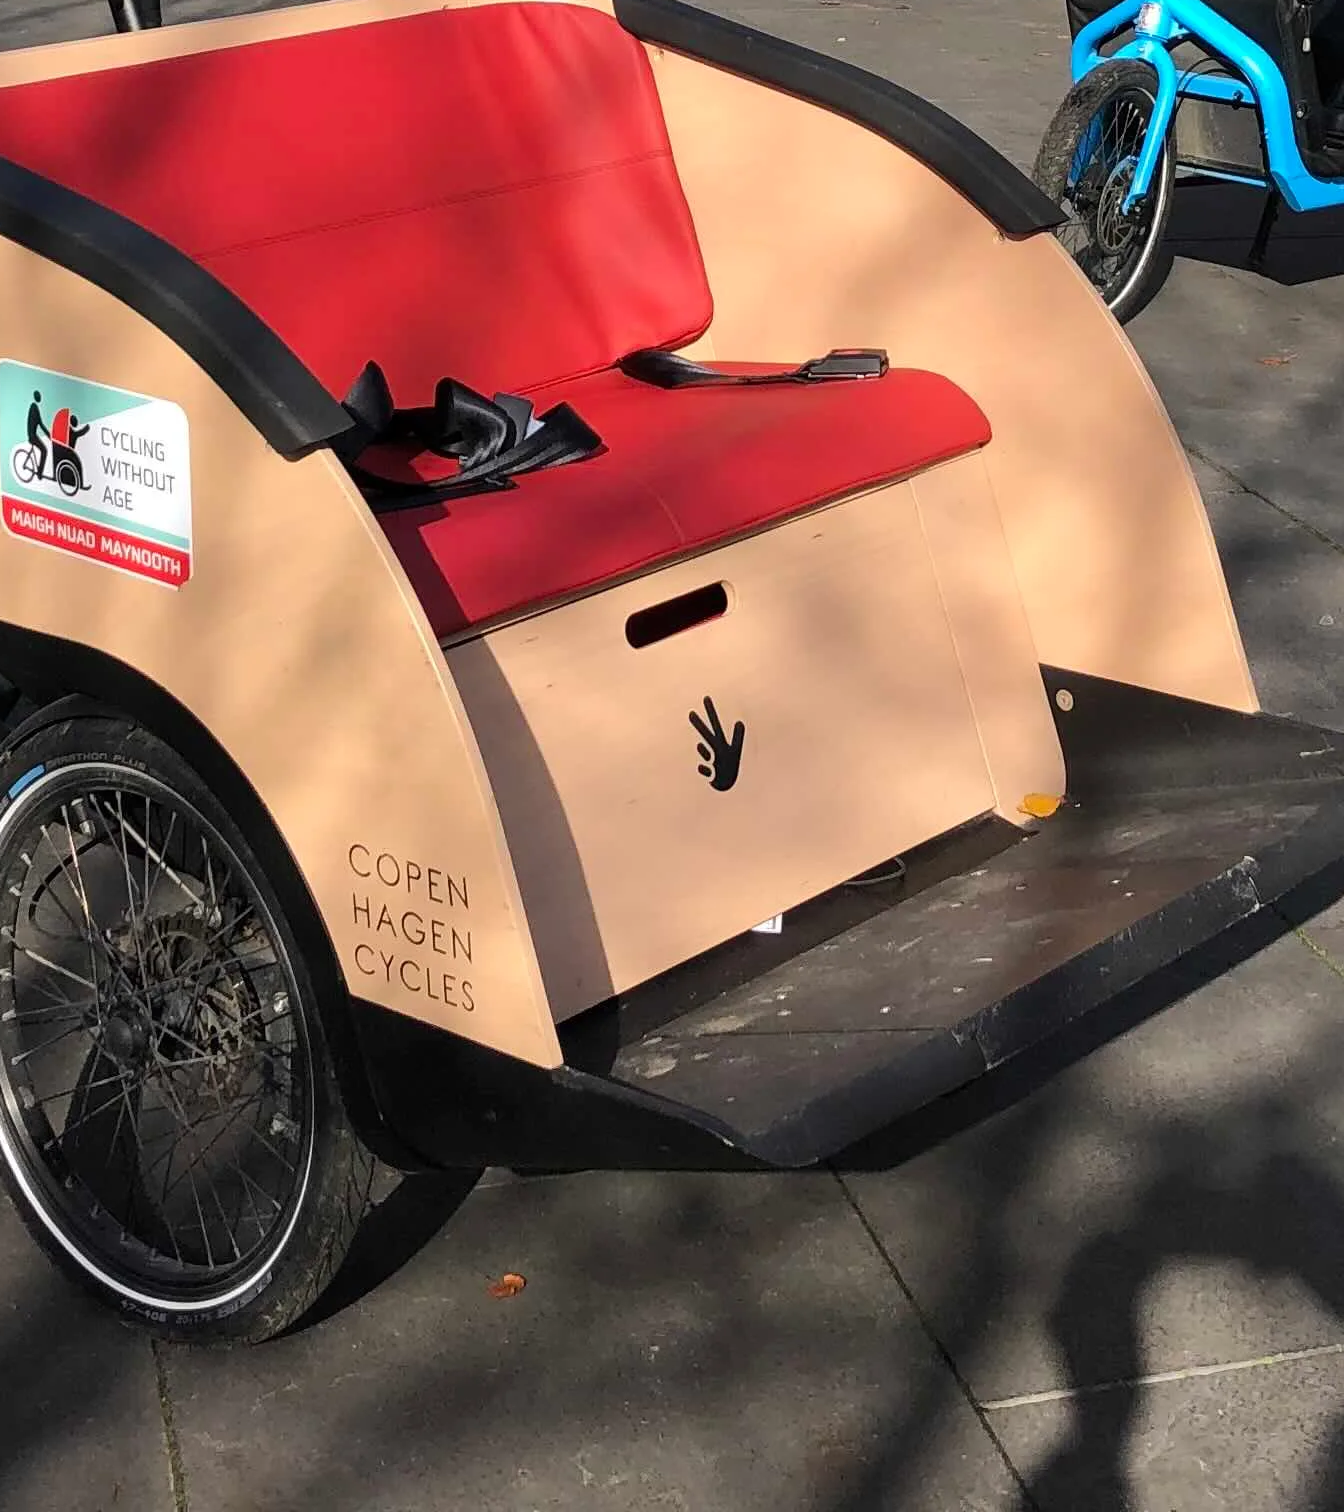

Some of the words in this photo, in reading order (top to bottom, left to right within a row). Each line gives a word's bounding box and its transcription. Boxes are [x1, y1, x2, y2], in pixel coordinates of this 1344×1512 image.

[101, 427, 165, 462] CYCLING
[101, 455, 175, 494] WITHOUT
[102, 485, 134, 511] AGE
[10, 508, 55, 537] MAIGH
[56, 523, 96, 549] NUAD
[100, 536, 182, 577] MAYNOOTH
[348, 843, 469, 910] COPEN
[352, 891, 473, 965] HAGEN
[354, 944, 475, 1012] CYCLES
